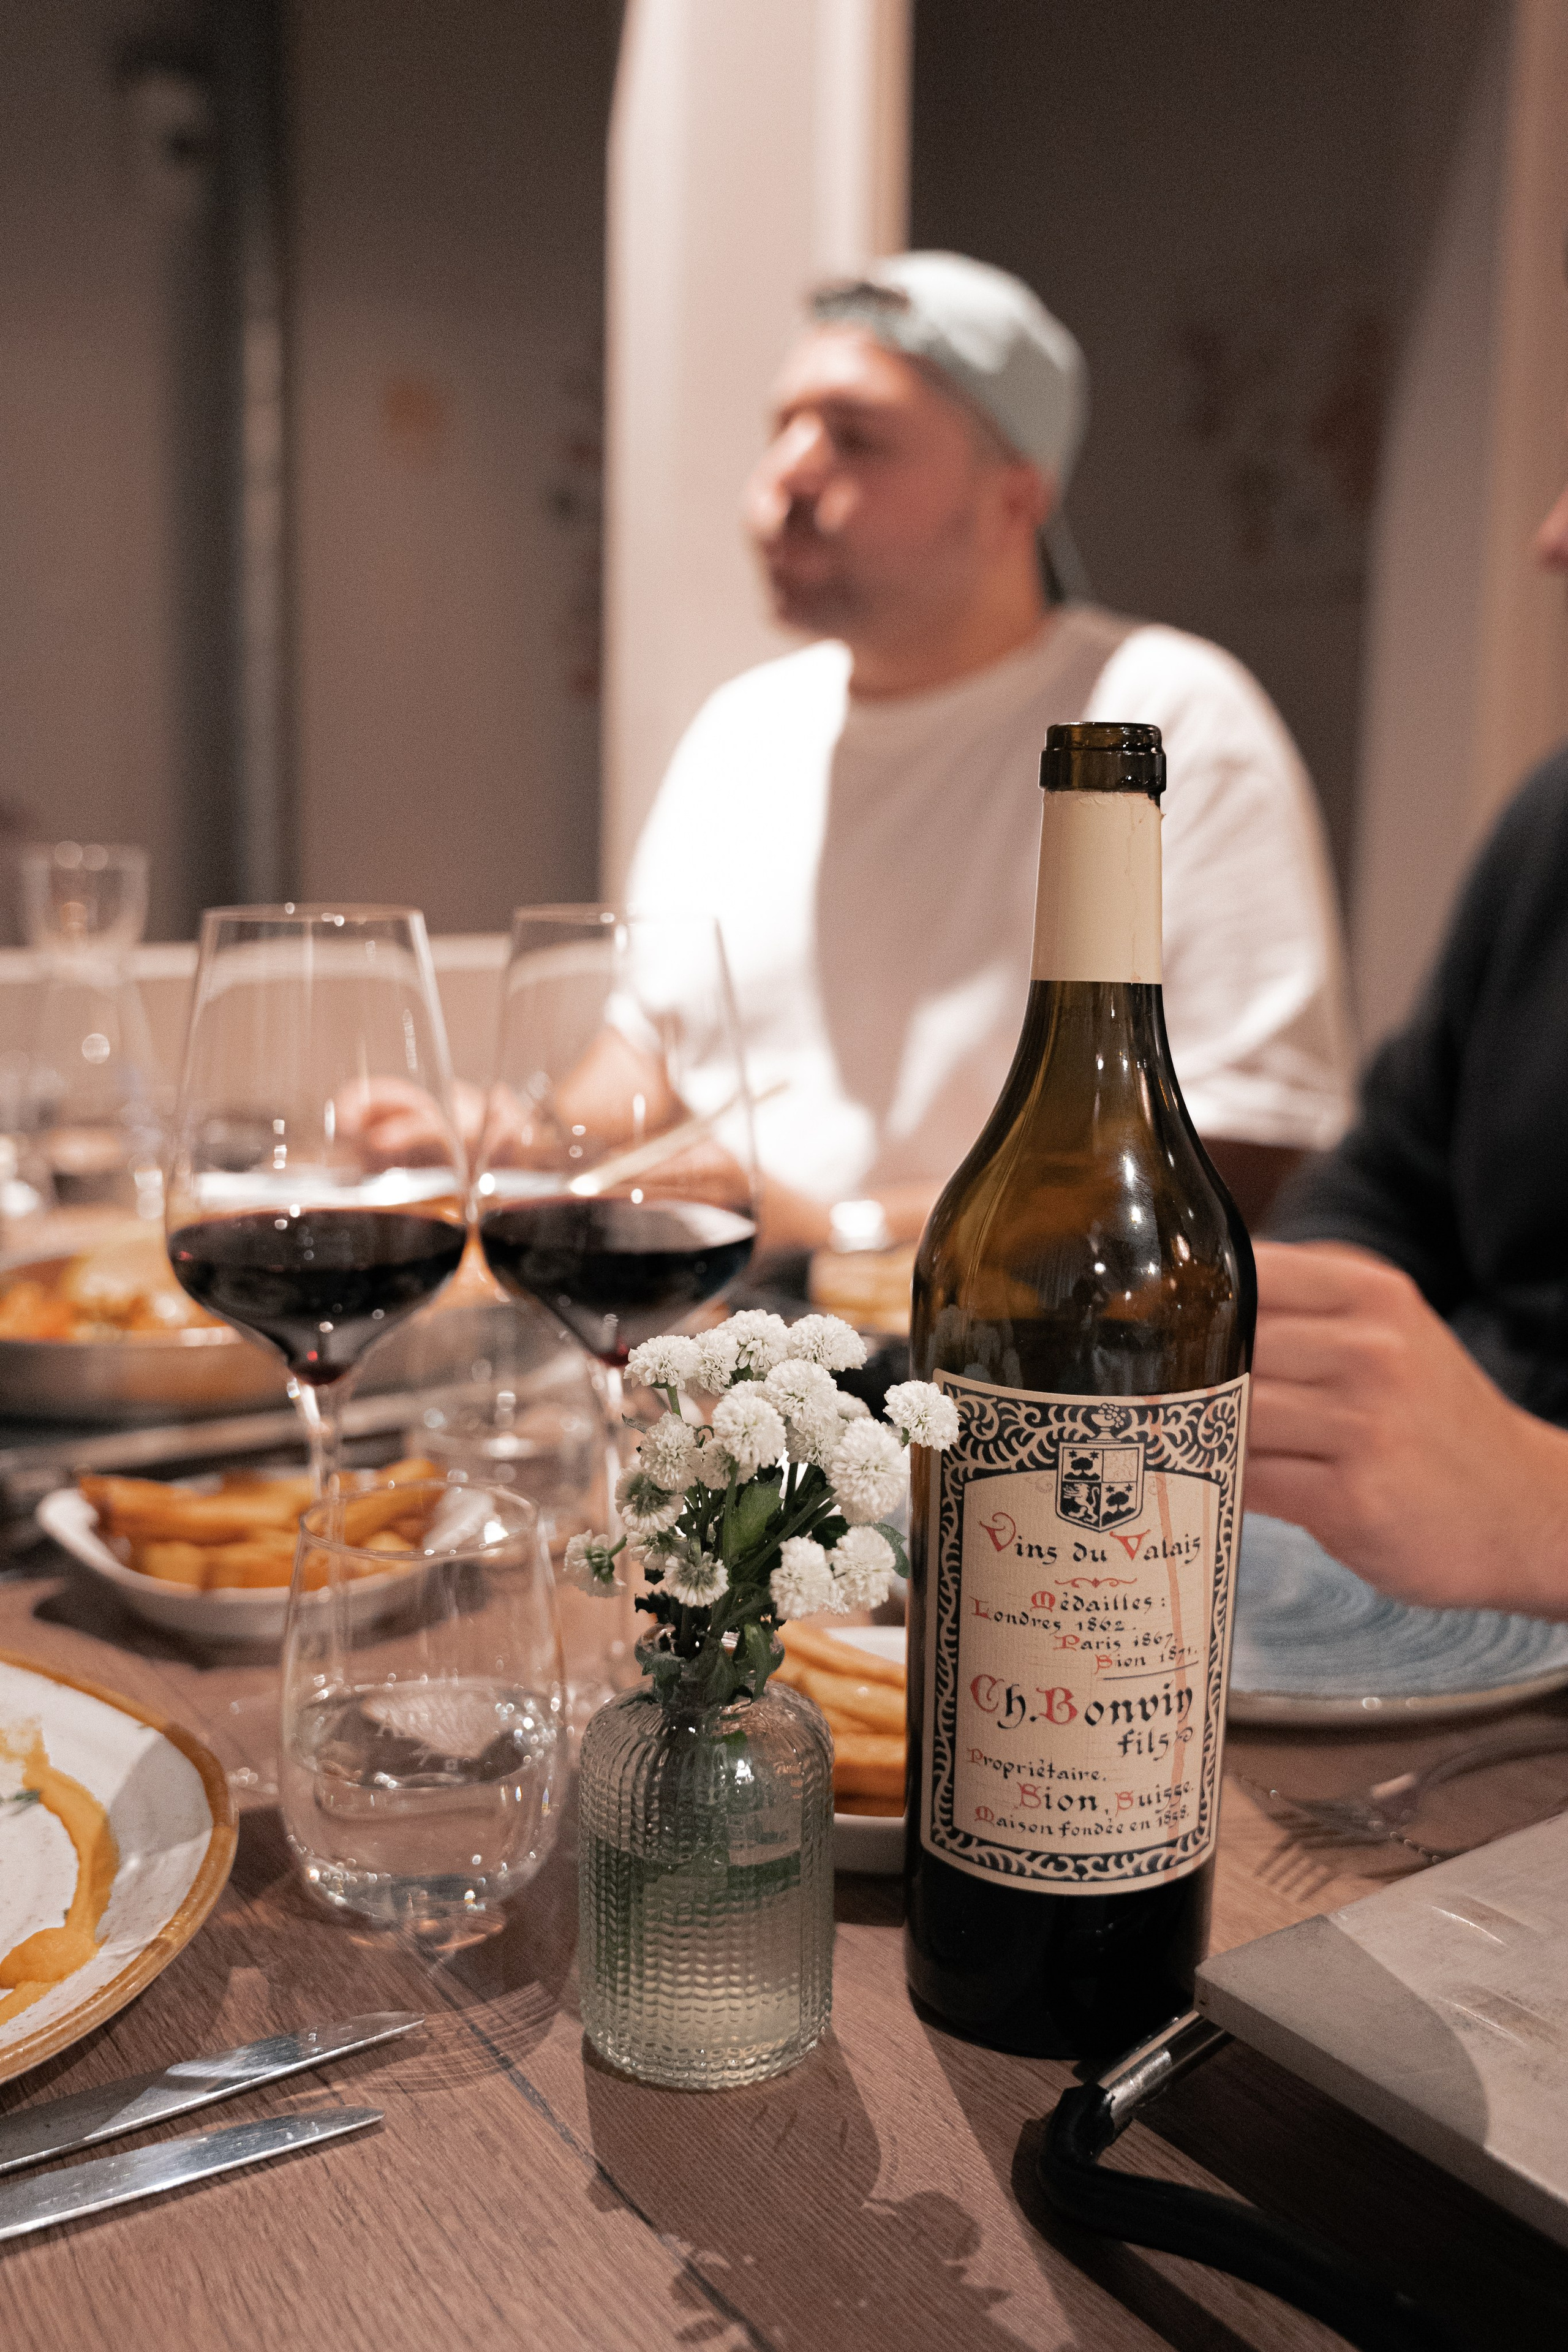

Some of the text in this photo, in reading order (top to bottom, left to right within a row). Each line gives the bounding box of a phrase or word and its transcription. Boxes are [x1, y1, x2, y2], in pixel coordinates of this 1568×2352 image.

[979, 1512, 1200, 1565] Vins du Valais
[970, 1595, 1061, 1635] Londres
[1053, 1634, 1121, 1653] Paris
[1094, 1654, 1145, 1674] Sion
[1118, 1727, 1169, 1761] fils
[974, 1806, 1054, 1834] Maison
[1059, 1818, 1124, 1838] fondée
[1130, 1821, 1150, 1831] en
